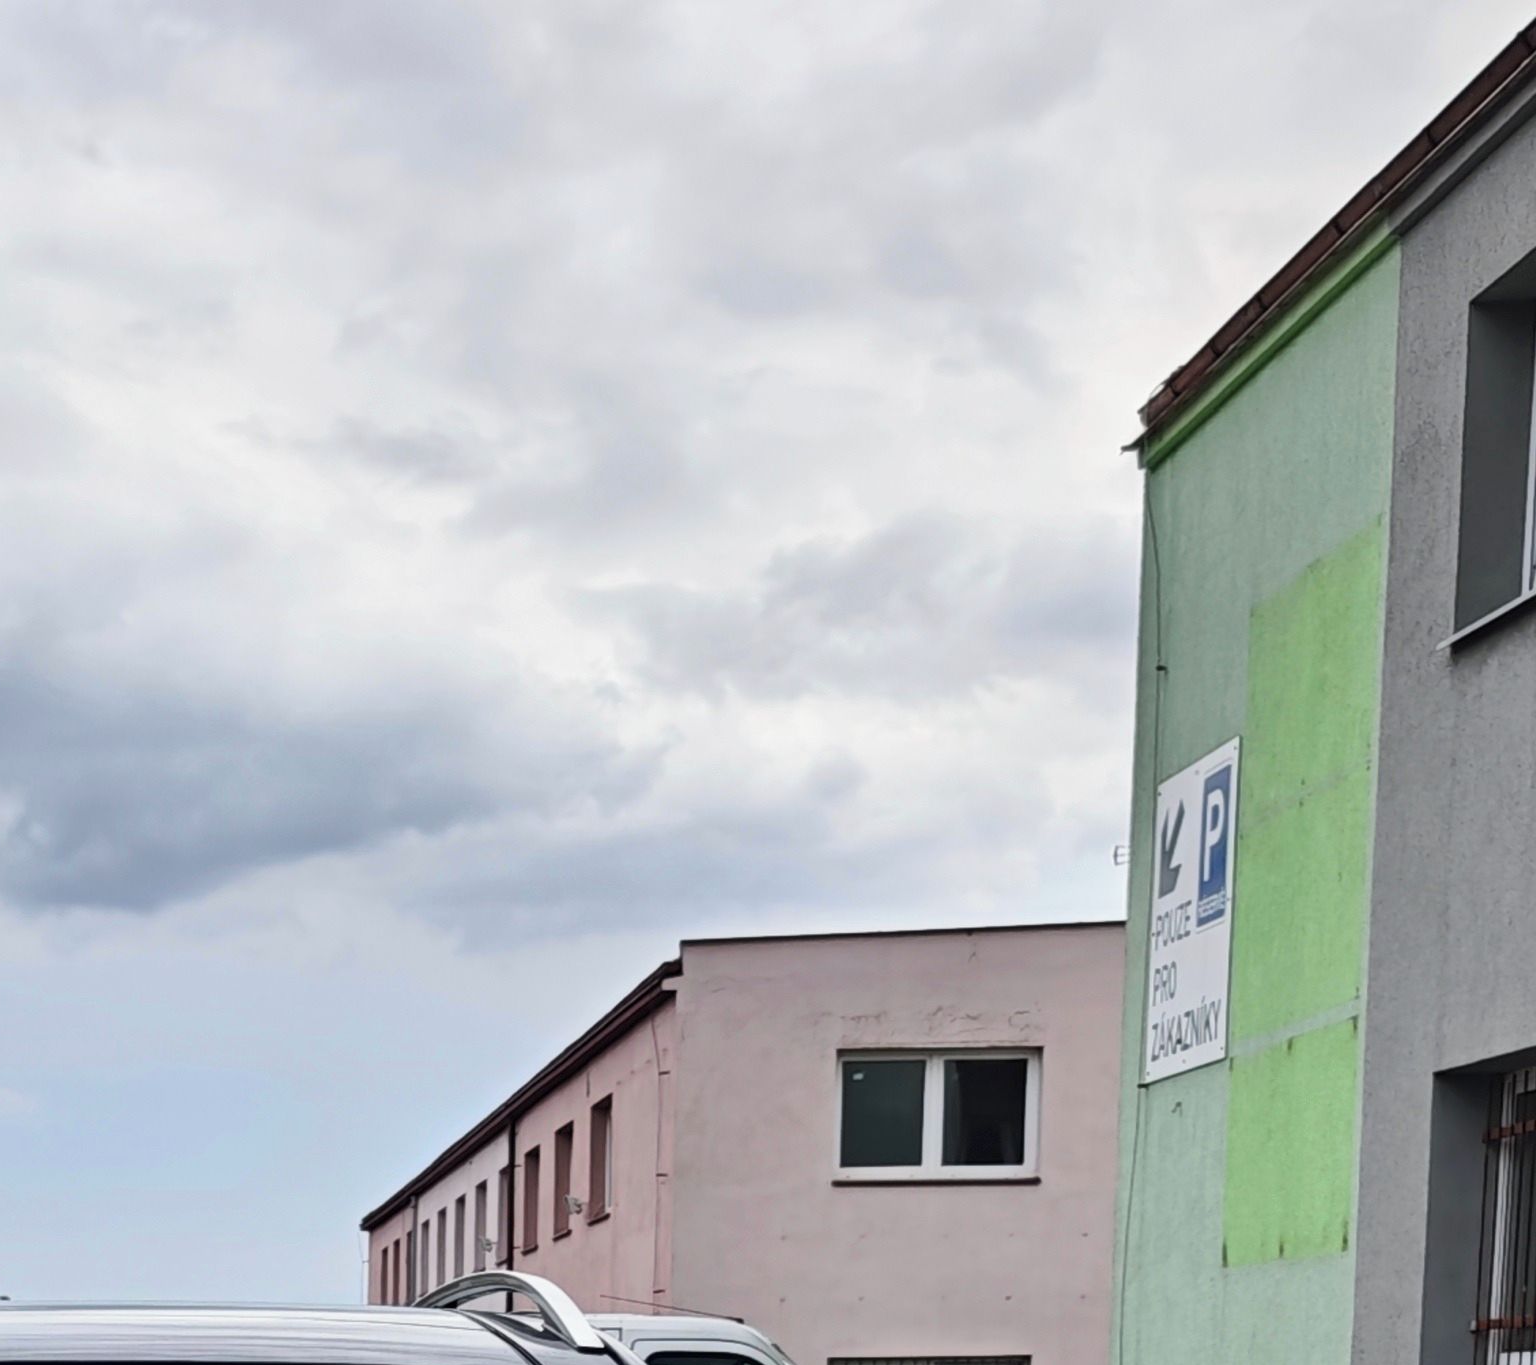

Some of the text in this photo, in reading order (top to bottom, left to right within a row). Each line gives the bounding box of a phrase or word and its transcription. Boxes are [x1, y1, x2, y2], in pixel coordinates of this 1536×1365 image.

[1203, 788, 1225, 882] P
[1154, 900, 1192, 951] POUZE
[1152, 961, 1177, 1007] PRO
[1151, 995, 1221, 1063] ZÁKAZNÍKY
